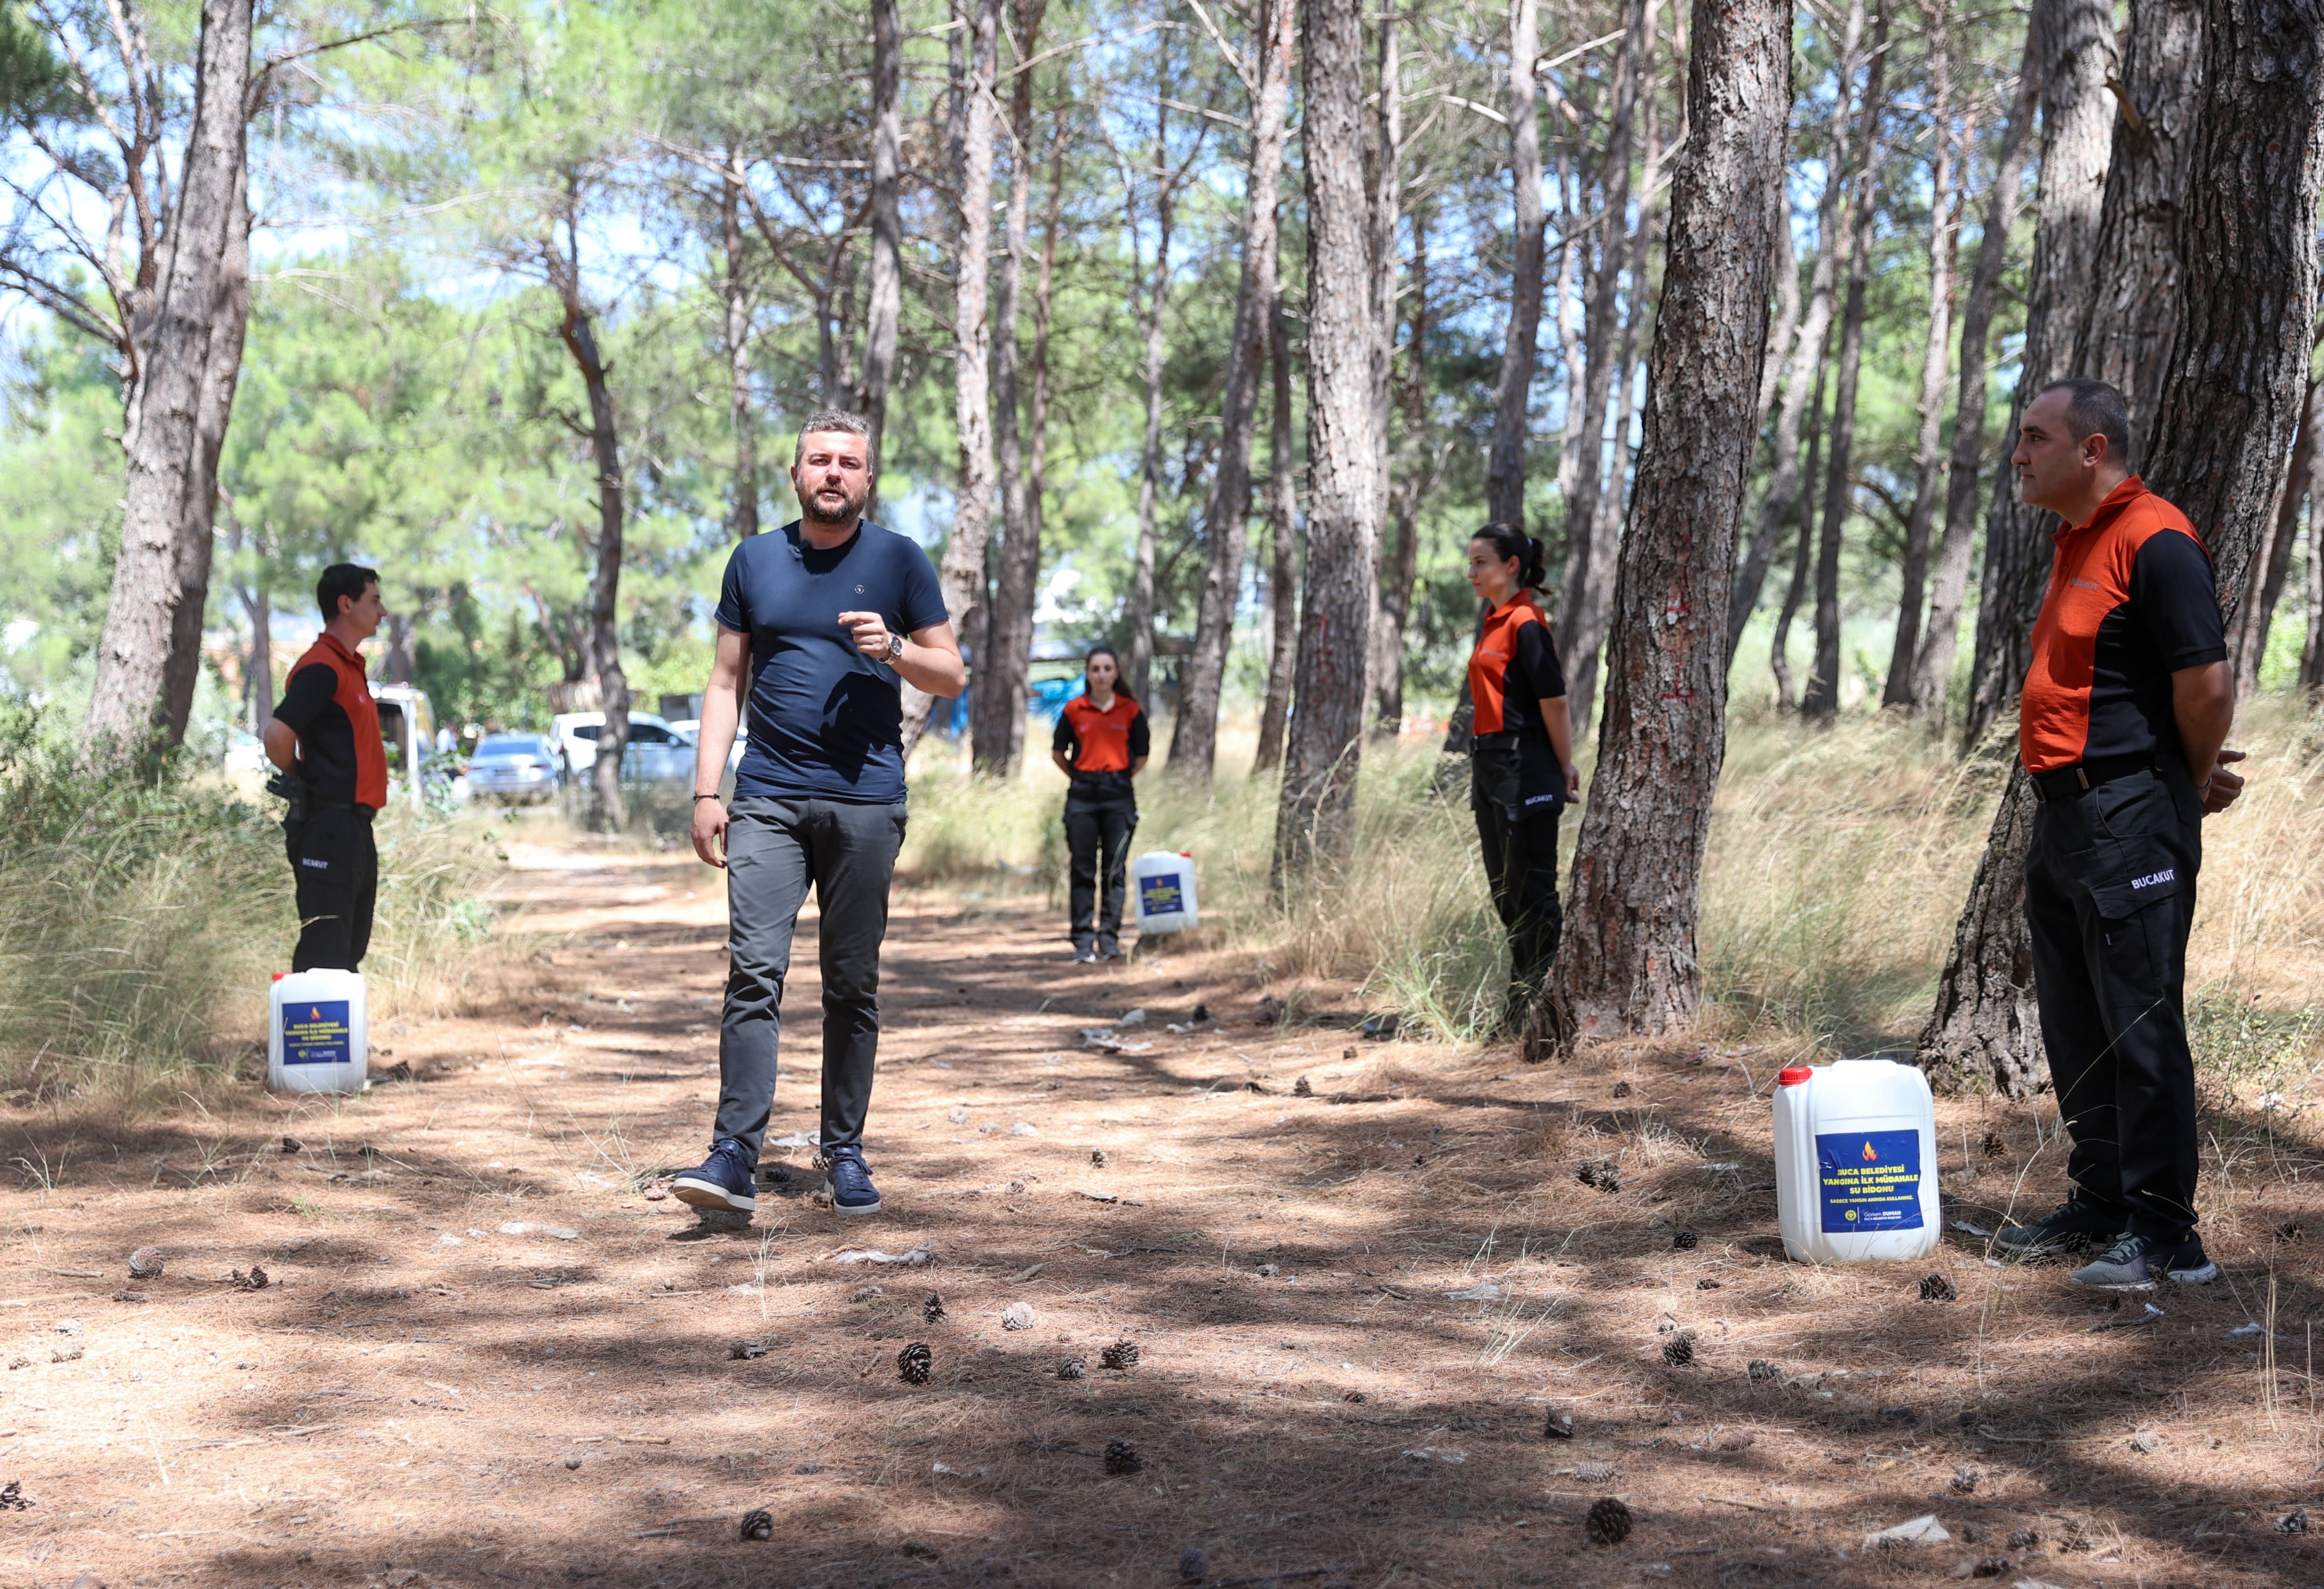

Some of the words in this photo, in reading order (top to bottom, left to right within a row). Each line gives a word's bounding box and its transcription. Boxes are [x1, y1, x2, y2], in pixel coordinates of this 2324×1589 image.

[2131, 869, 2175, 890] BUCAKUT
[1837, 1168, 1859, 1176] BUCA
[1860, 1164, 1905, 1175] BELEDİYESİ
[1861, 1176, 1874, 1184] İLK
[1875, 1174, 1919, 1183] MÜDAHALE
[1862, 1185, 1894, 1194] BİDONU
